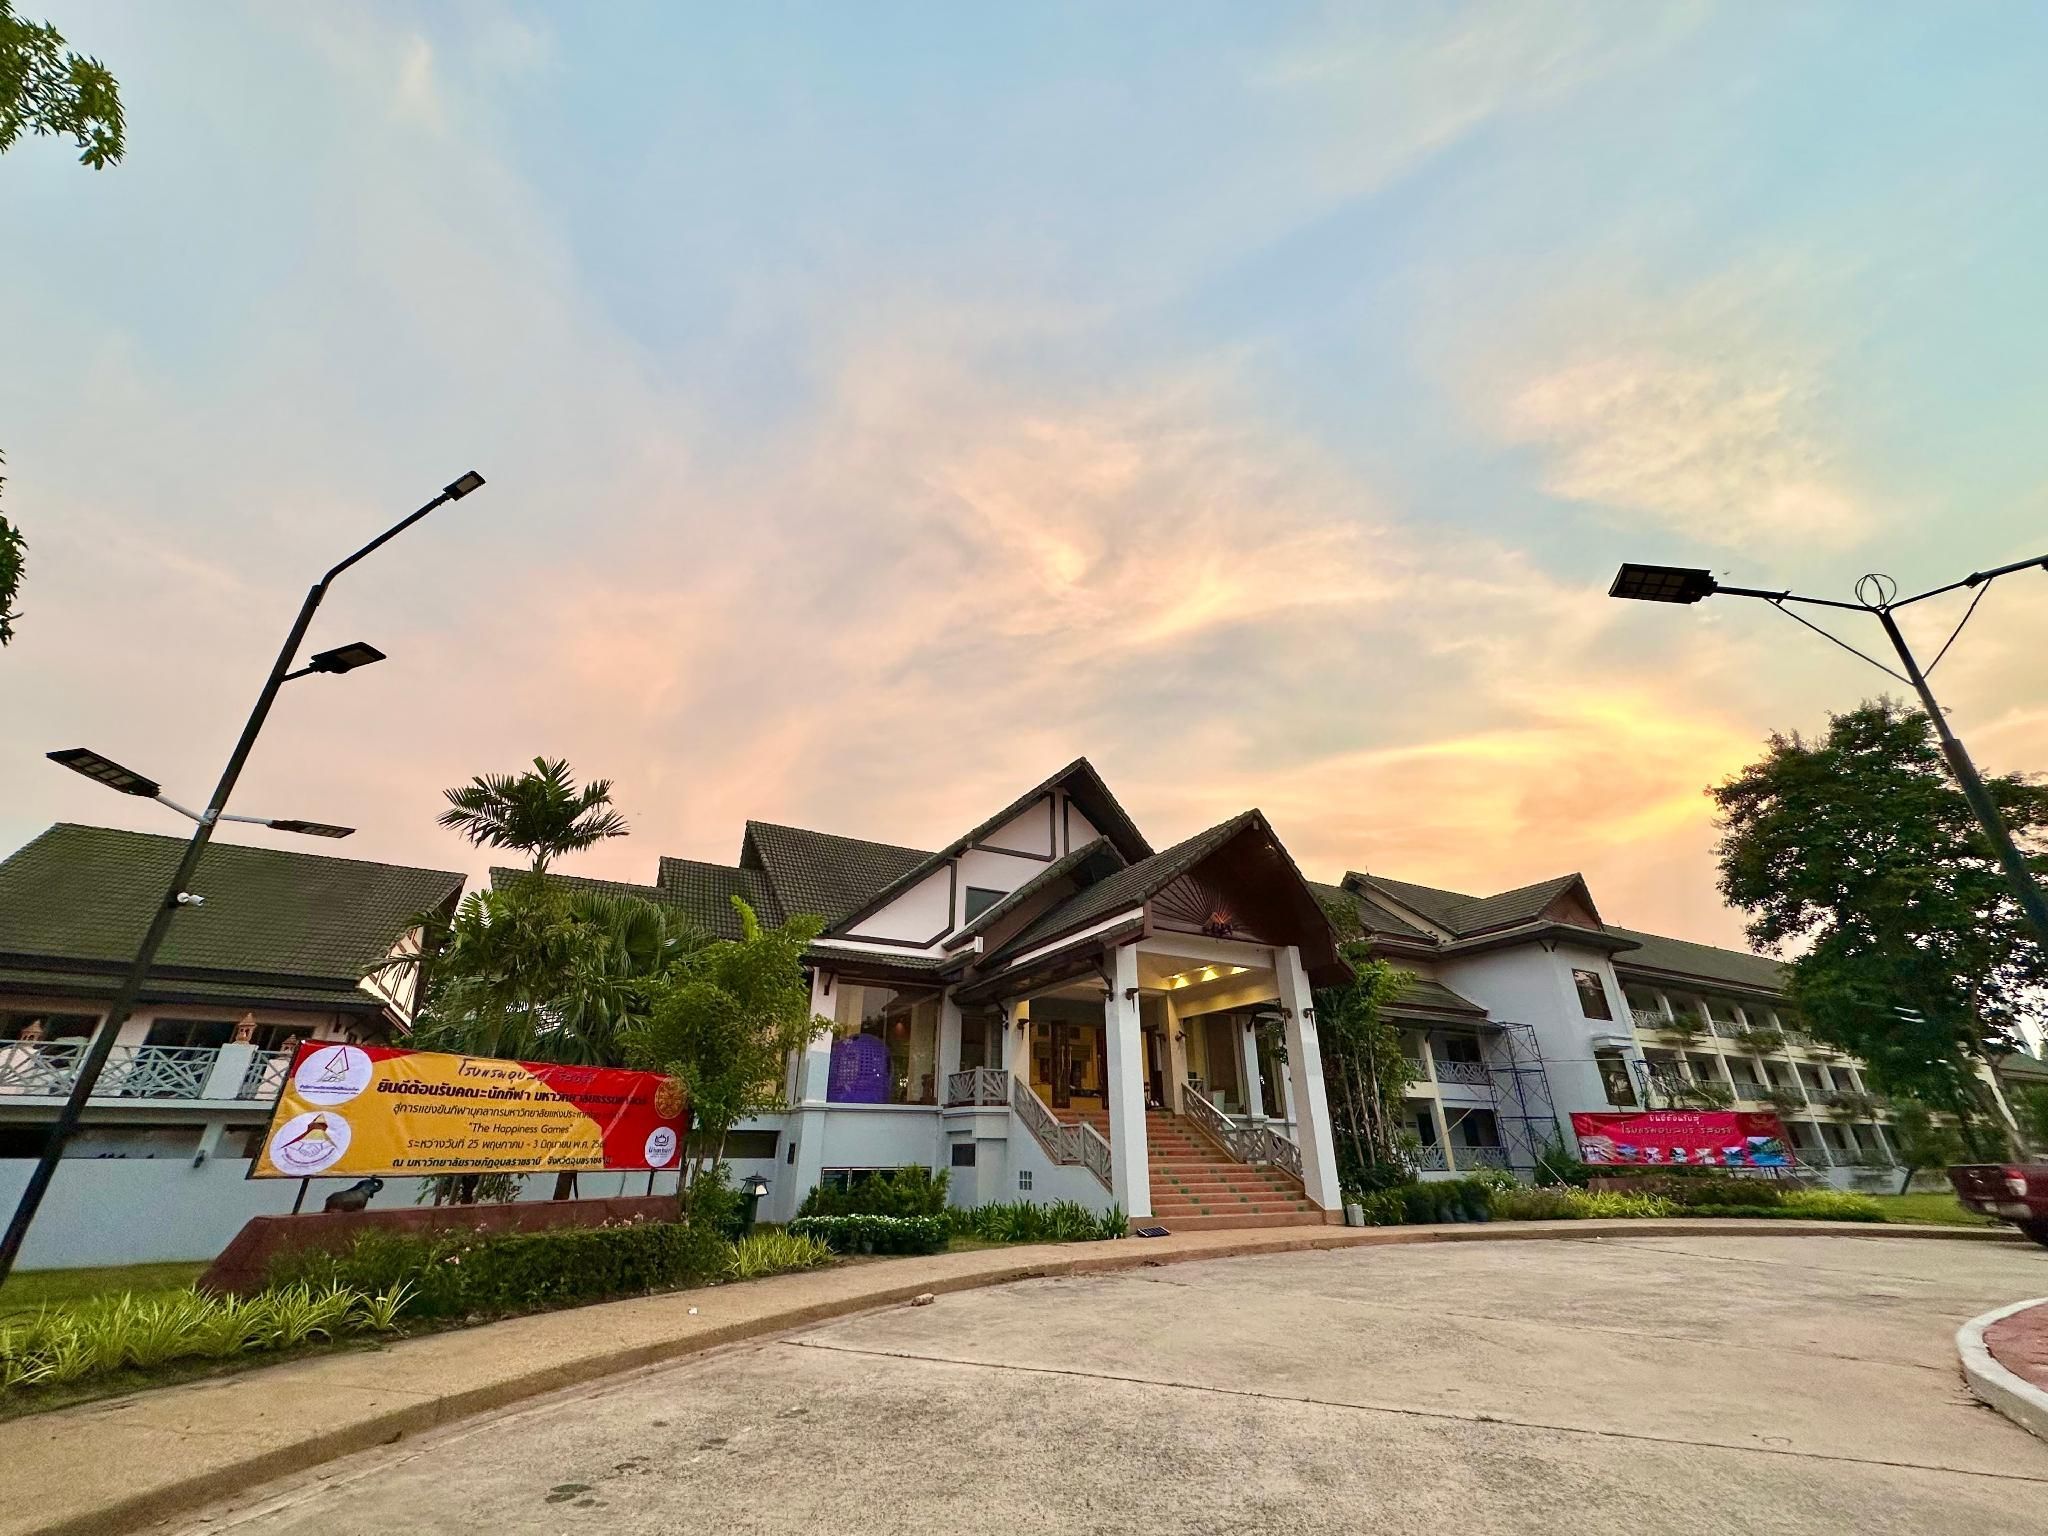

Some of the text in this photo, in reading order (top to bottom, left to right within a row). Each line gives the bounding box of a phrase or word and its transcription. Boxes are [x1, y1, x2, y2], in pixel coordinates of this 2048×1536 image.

[377, 1079, 531, 1101] ยินดีต้อนรับคณะนักกีฬา
[469, 1122, 574, 1135] "The Happiness Games"
[408, 1136, 466, 1149] ระหว่างวันที่
[467, 1139, 480, 1149] 25
[482, 1139, 524, 1151] พฤษภาคม
[392, 1158, 403, 1167] ณ
